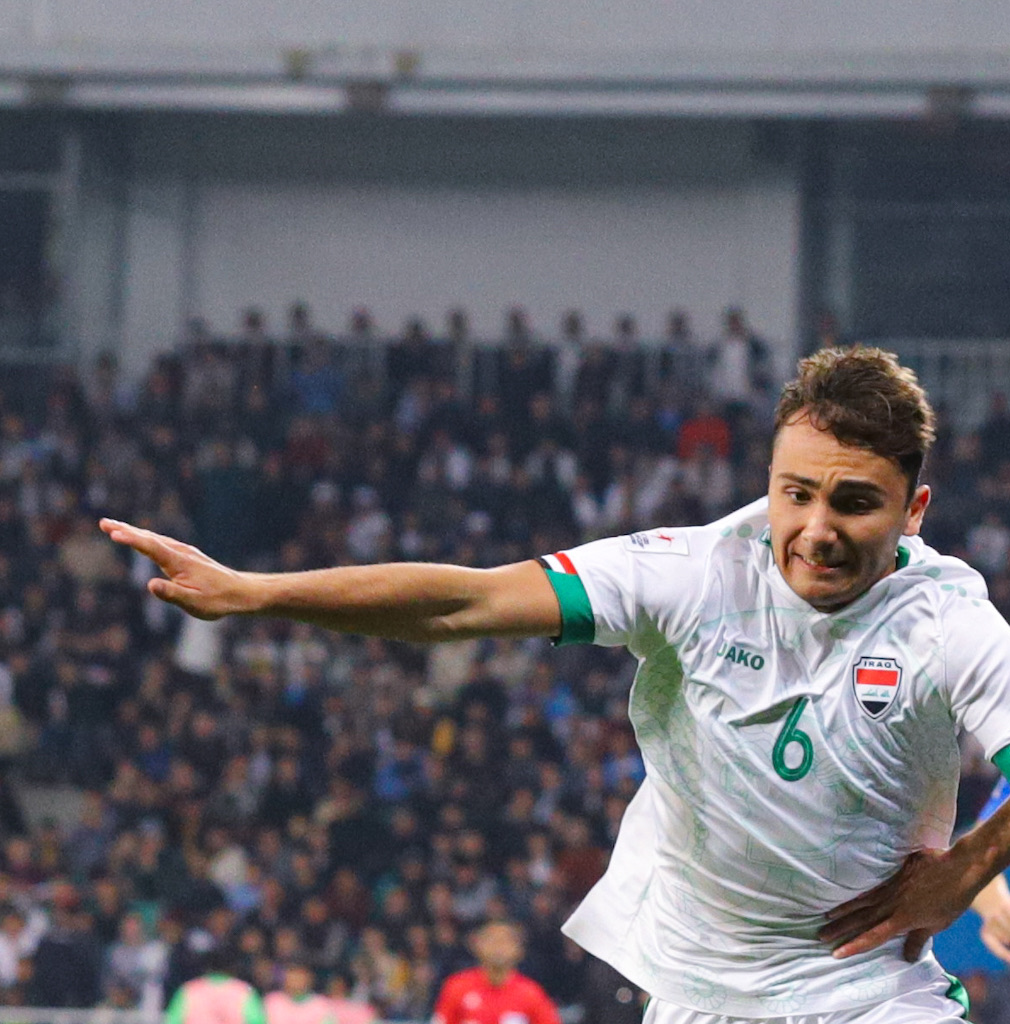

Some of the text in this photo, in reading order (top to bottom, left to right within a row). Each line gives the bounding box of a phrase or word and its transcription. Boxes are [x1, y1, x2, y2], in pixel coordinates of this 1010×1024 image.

[717, 643, 765, 671] JAKO
[863, 660, 892, 668] IRAQ
[772, 696, 814, 782] 6
